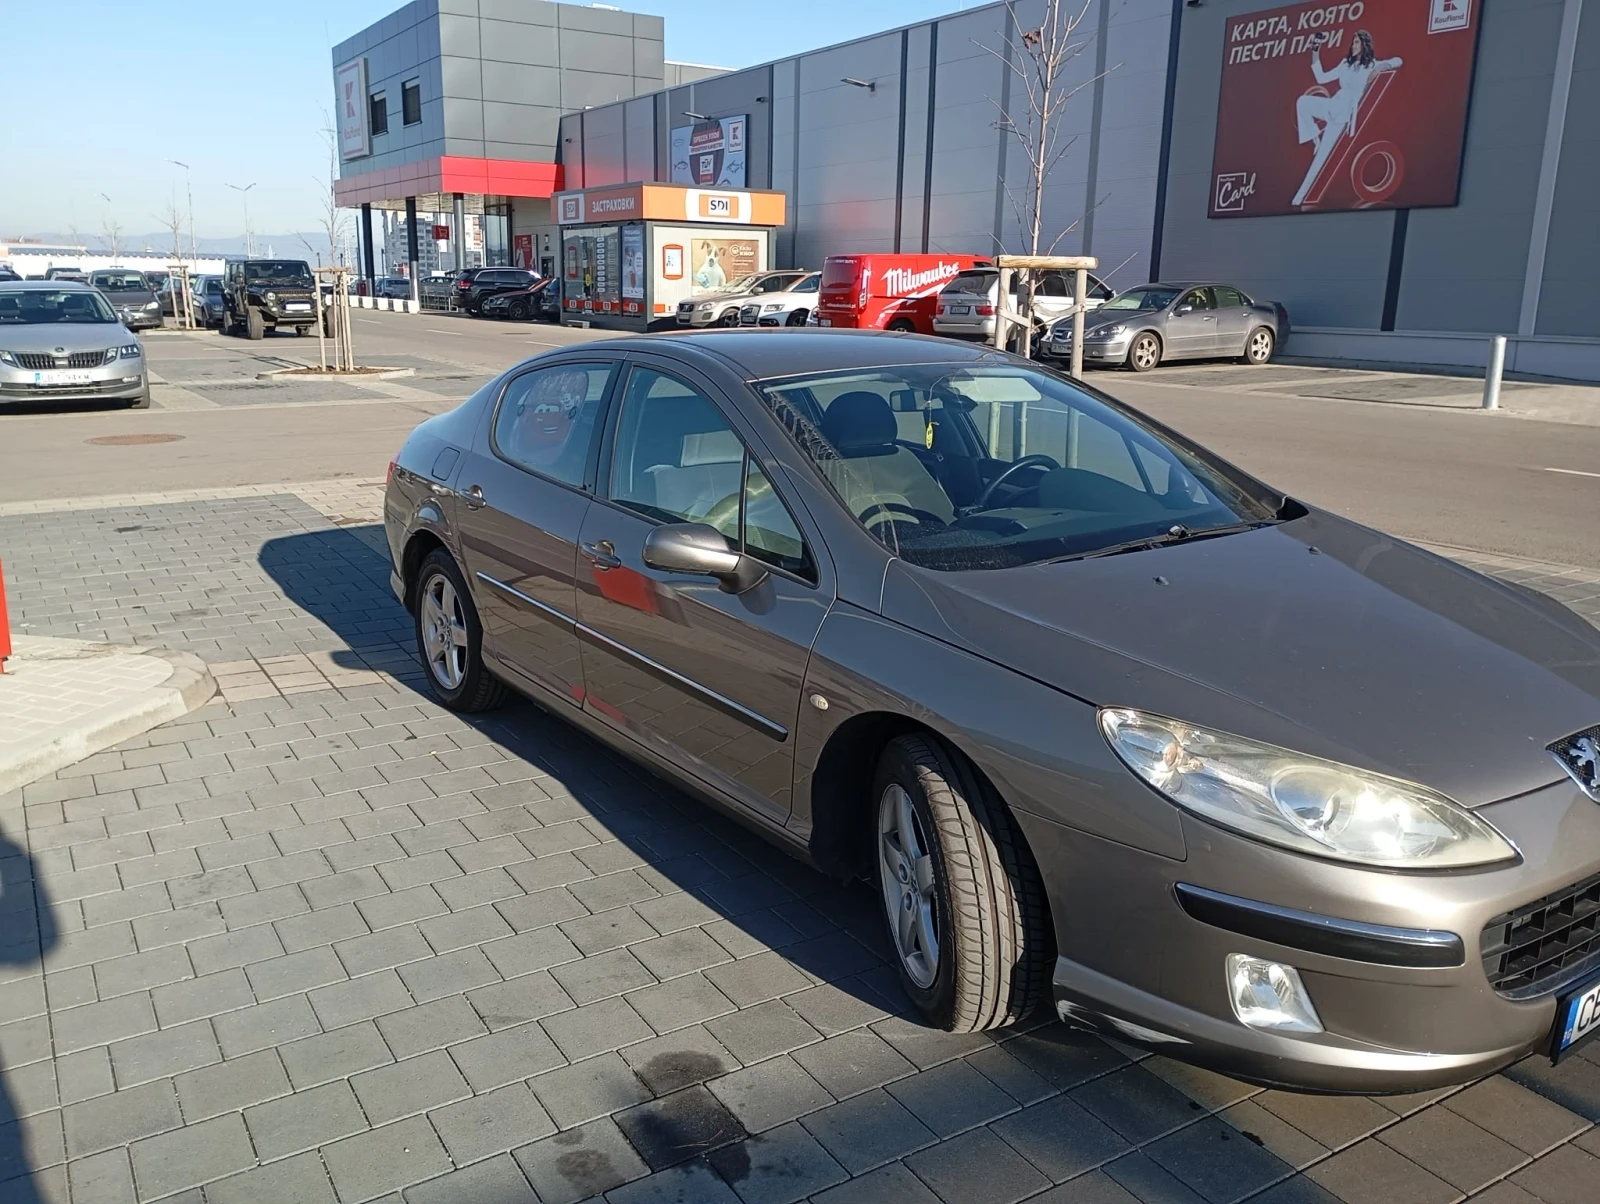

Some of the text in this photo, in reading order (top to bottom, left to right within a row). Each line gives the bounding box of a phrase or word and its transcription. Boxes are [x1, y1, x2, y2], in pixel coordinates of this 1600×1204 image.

[1230, 1, 1365, 43] КАРТА, КОЯТО
[1434, 12, 1465, 24] Kaufland
[1229, 38, 1286, 65] ПЕСТИ
[1219, 172, 1257, 207] Card
[567, 202, 576, 214] SDI
[592, 198, 635, 213] ЗАСТРАХОВКИ
[710, 200, 728, 211] SDI
[881, 261, 960, 297] Milwaukee
